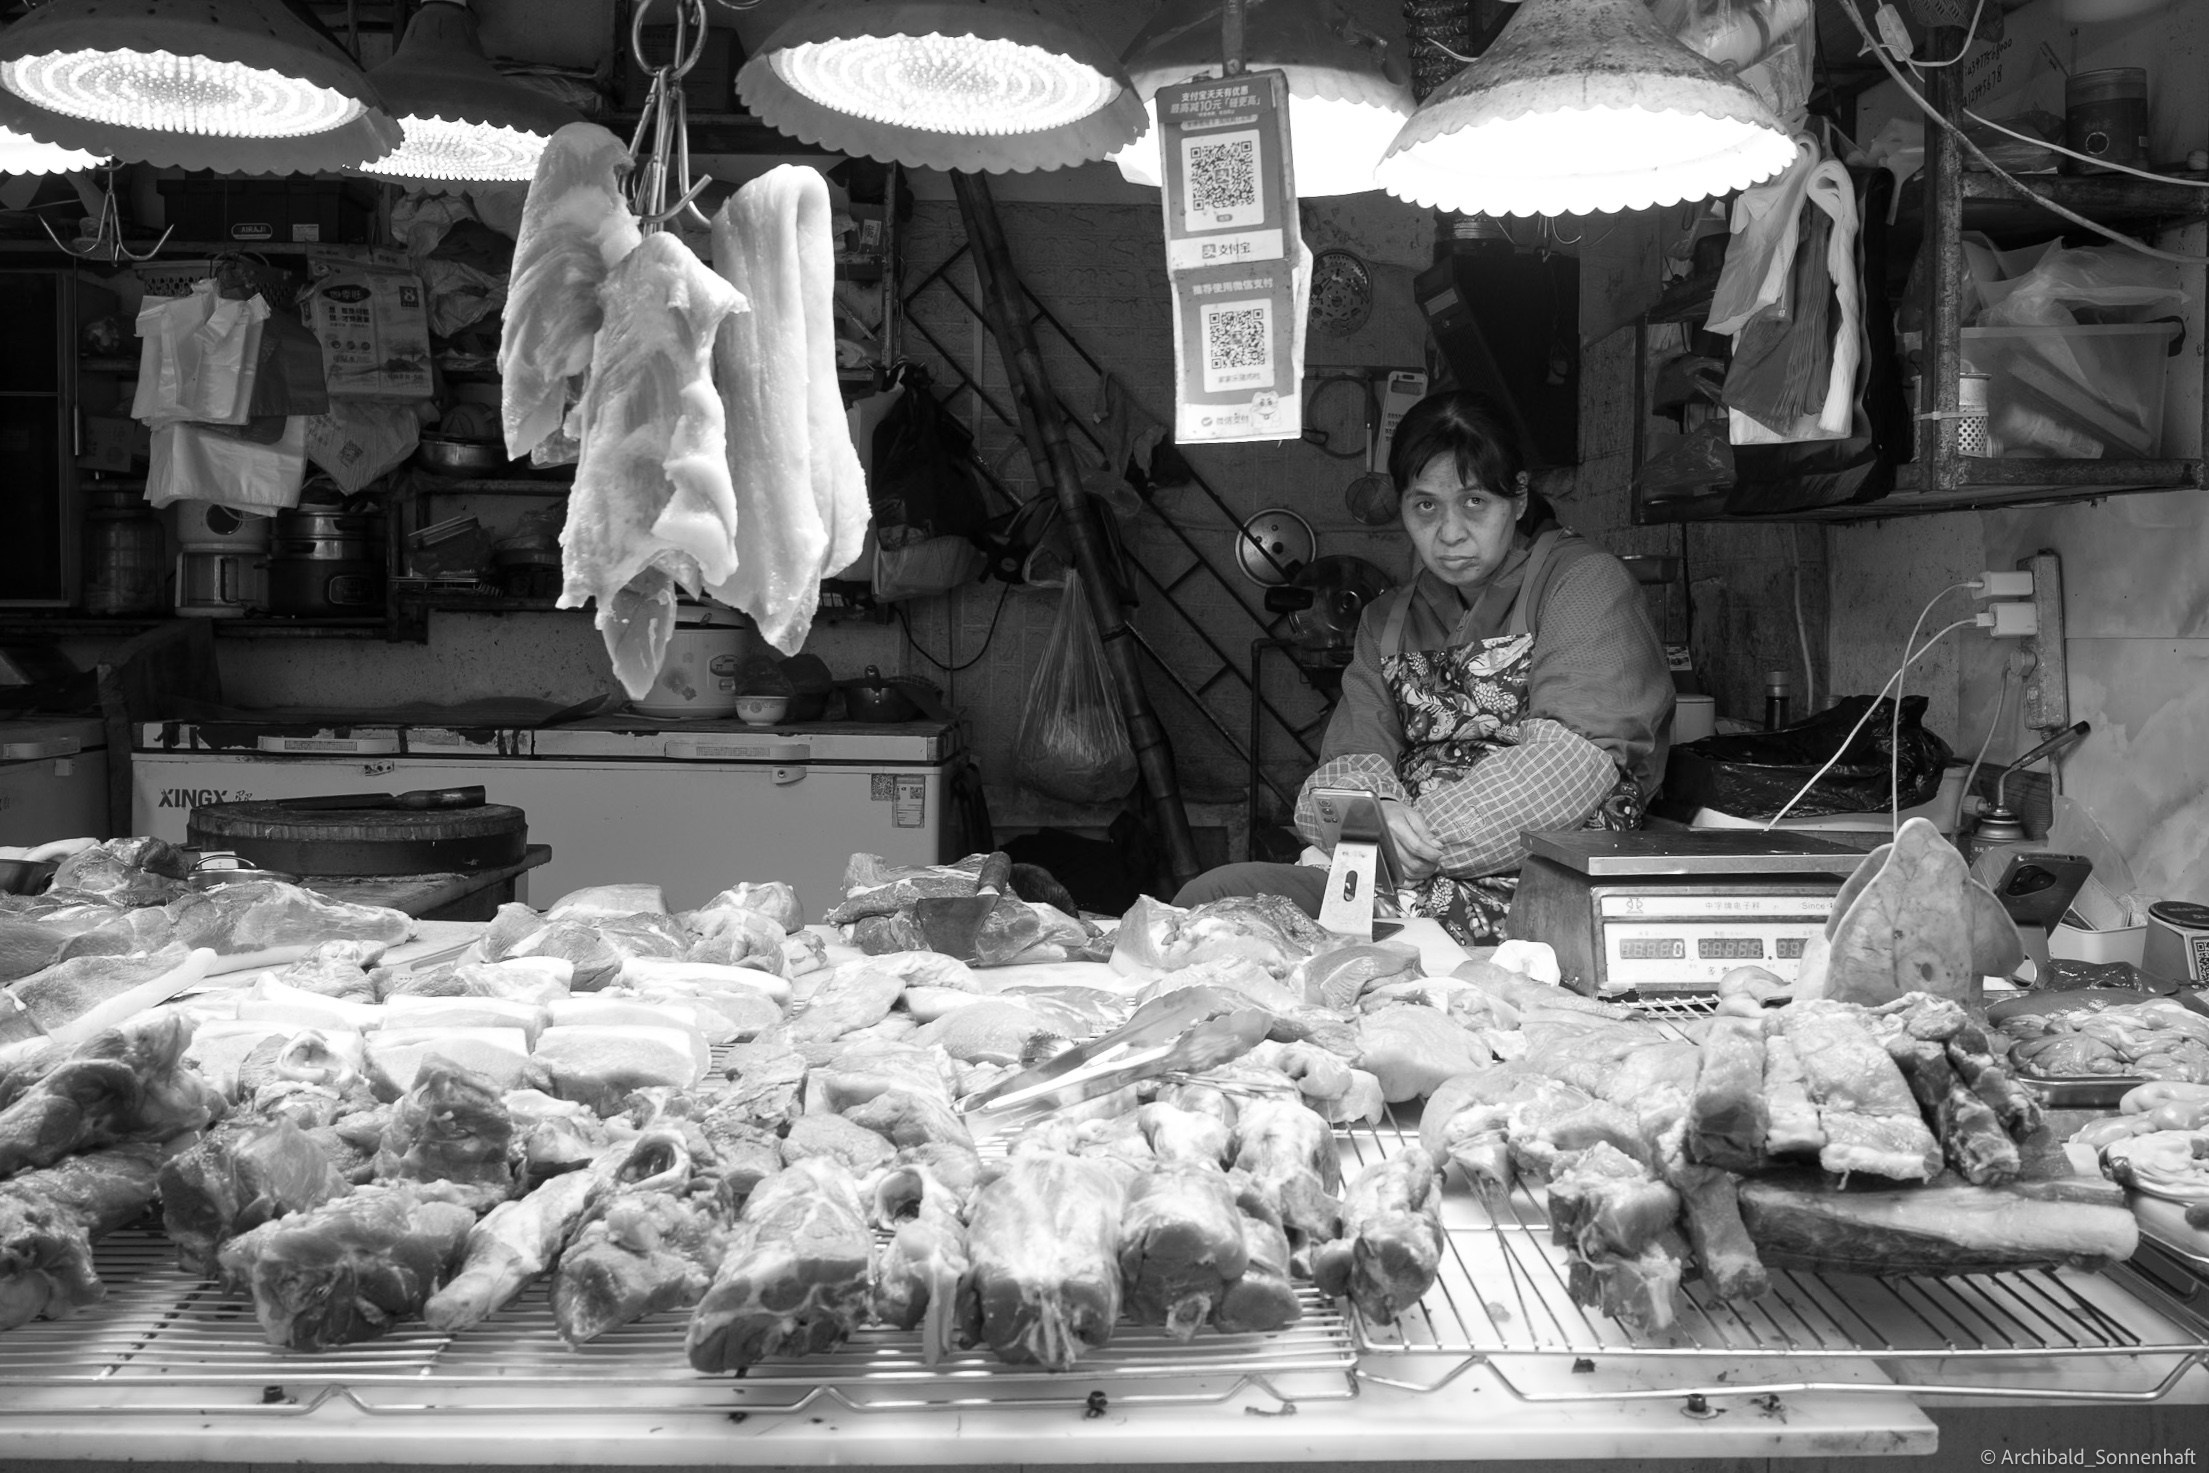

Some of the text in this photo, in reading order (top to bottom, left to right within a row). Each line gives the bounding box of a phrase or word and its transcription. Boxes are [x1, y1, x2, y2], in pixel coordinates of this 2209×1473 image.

[1181, 85, 1248, 102] 支付宝天天有优惠
[1219, 242, 1251, 256] 支付宝
[1192, 277, 1273, 296] 推荐使用微信支付
[1216, 415, 1249, 425] 微信支付
